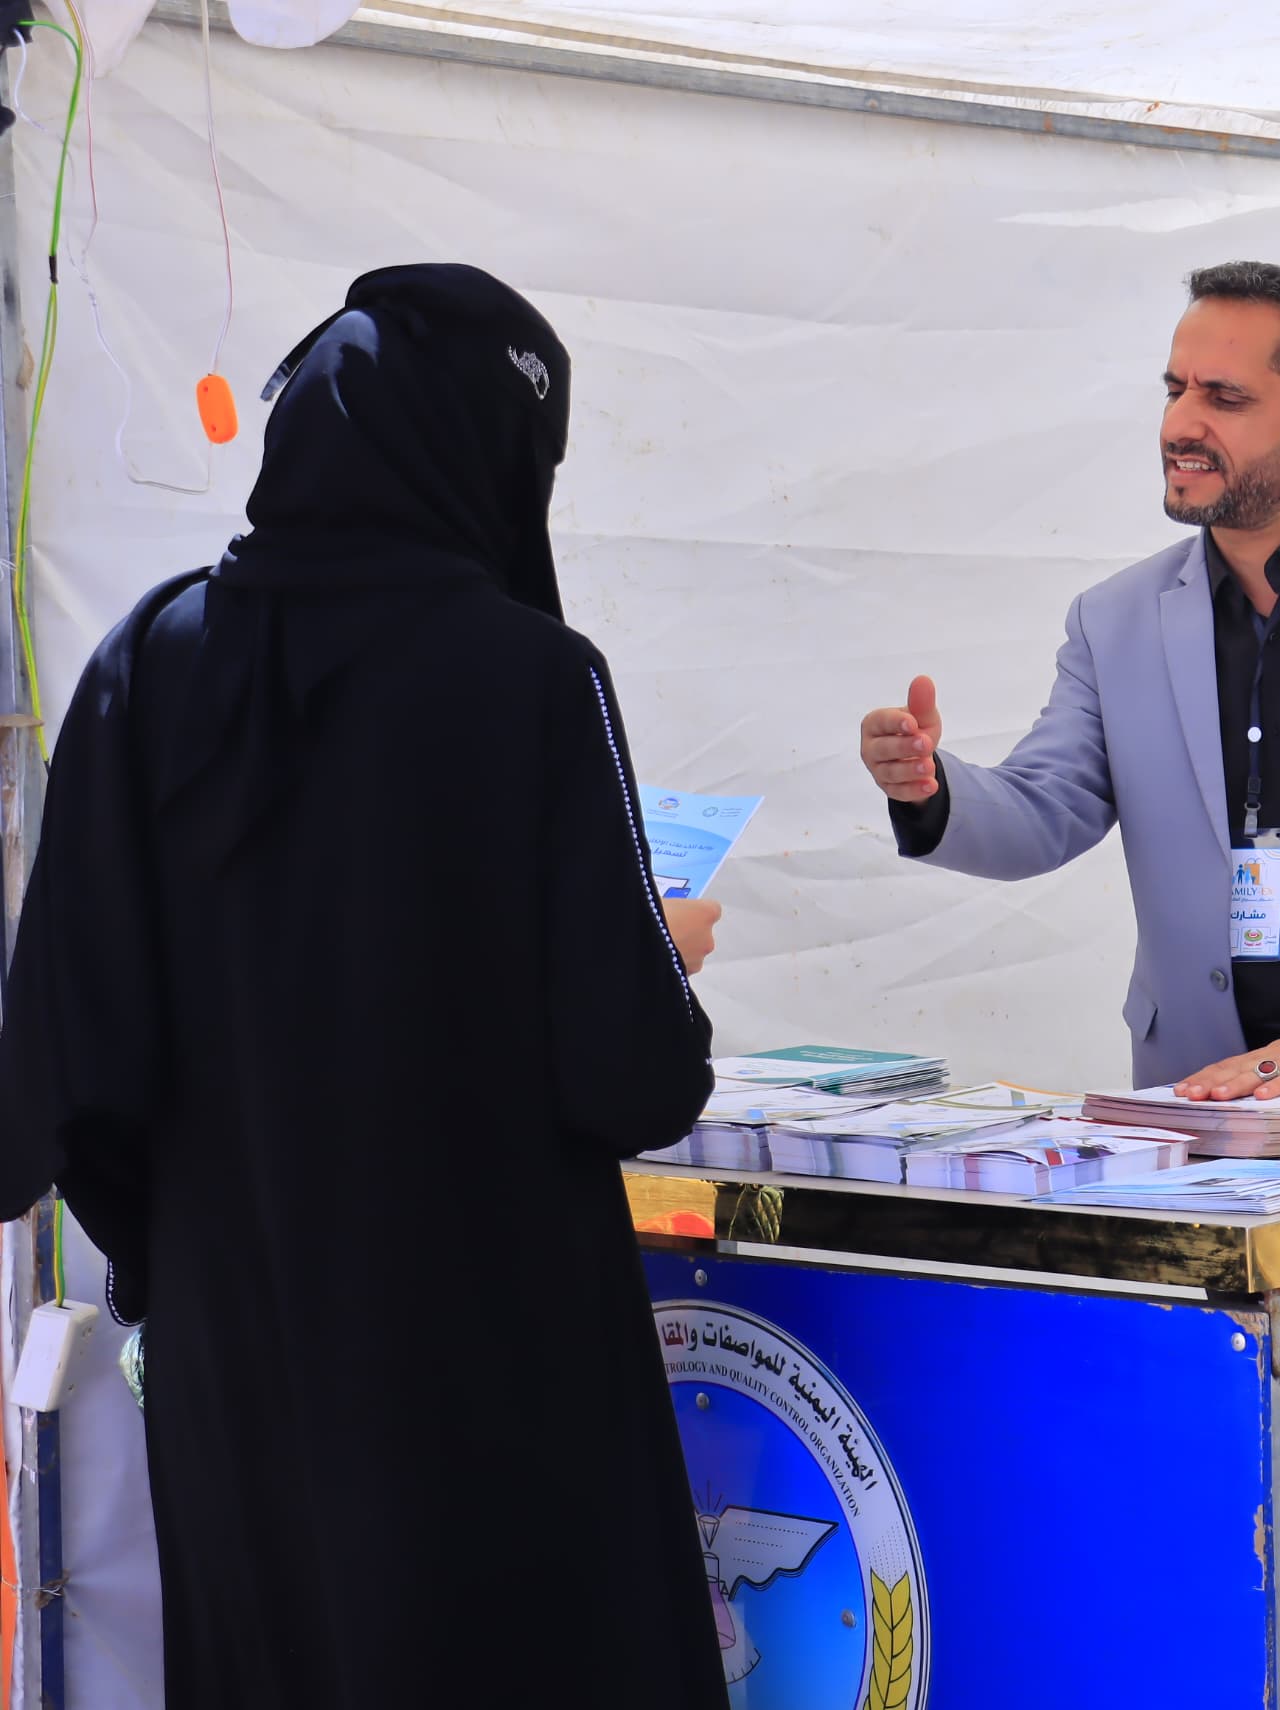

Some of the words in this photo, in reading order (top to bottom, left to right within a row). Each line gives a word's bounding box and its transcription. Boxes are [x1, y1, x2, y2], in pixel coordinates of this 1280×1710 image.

[662, 1321, 698, 1350] والمقا
[666, 1360, 706, 1376] TROLOGY
[709, 1362, 728, 1376] AND
[730, 1368, 769, 1398] QUALITY
[770, 1391, 810, 1436] CONTROL
[810, 1432, 860, 1518] ORGANIZATION
